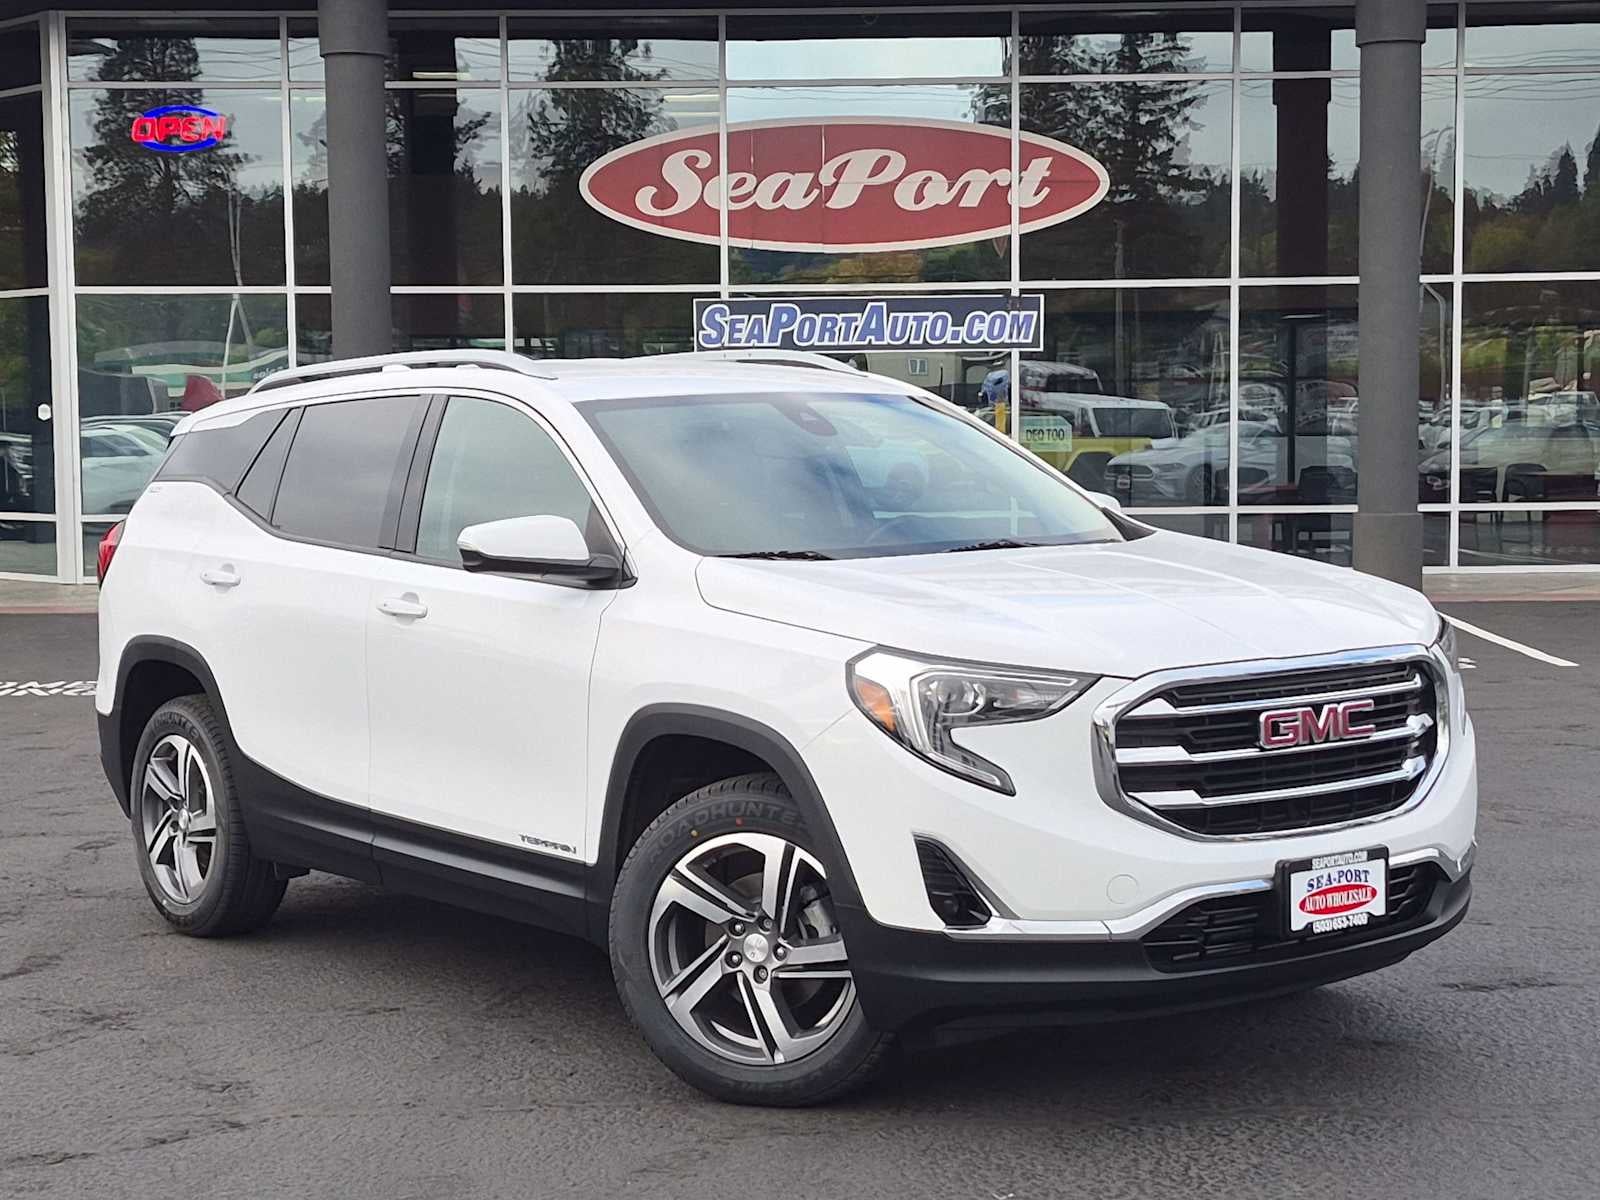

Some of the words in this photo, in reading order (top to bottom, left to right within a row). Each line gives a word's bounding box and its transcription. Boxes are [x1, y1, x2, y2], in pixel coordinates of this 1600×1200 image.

[131, 116, 226, 142] OPEN
[634, 148, 1053, 217] SeaPort
[701, 302, 1038, 348] SEAPORTAUTO.COM
[1260, 699, 1376, 749] GMC
[1307, 869, 1370, 892] SEA-PORT
[1304, 894, 1326, 912] AUTO
[1326, 888, 1373, 908] WHOLESALE
